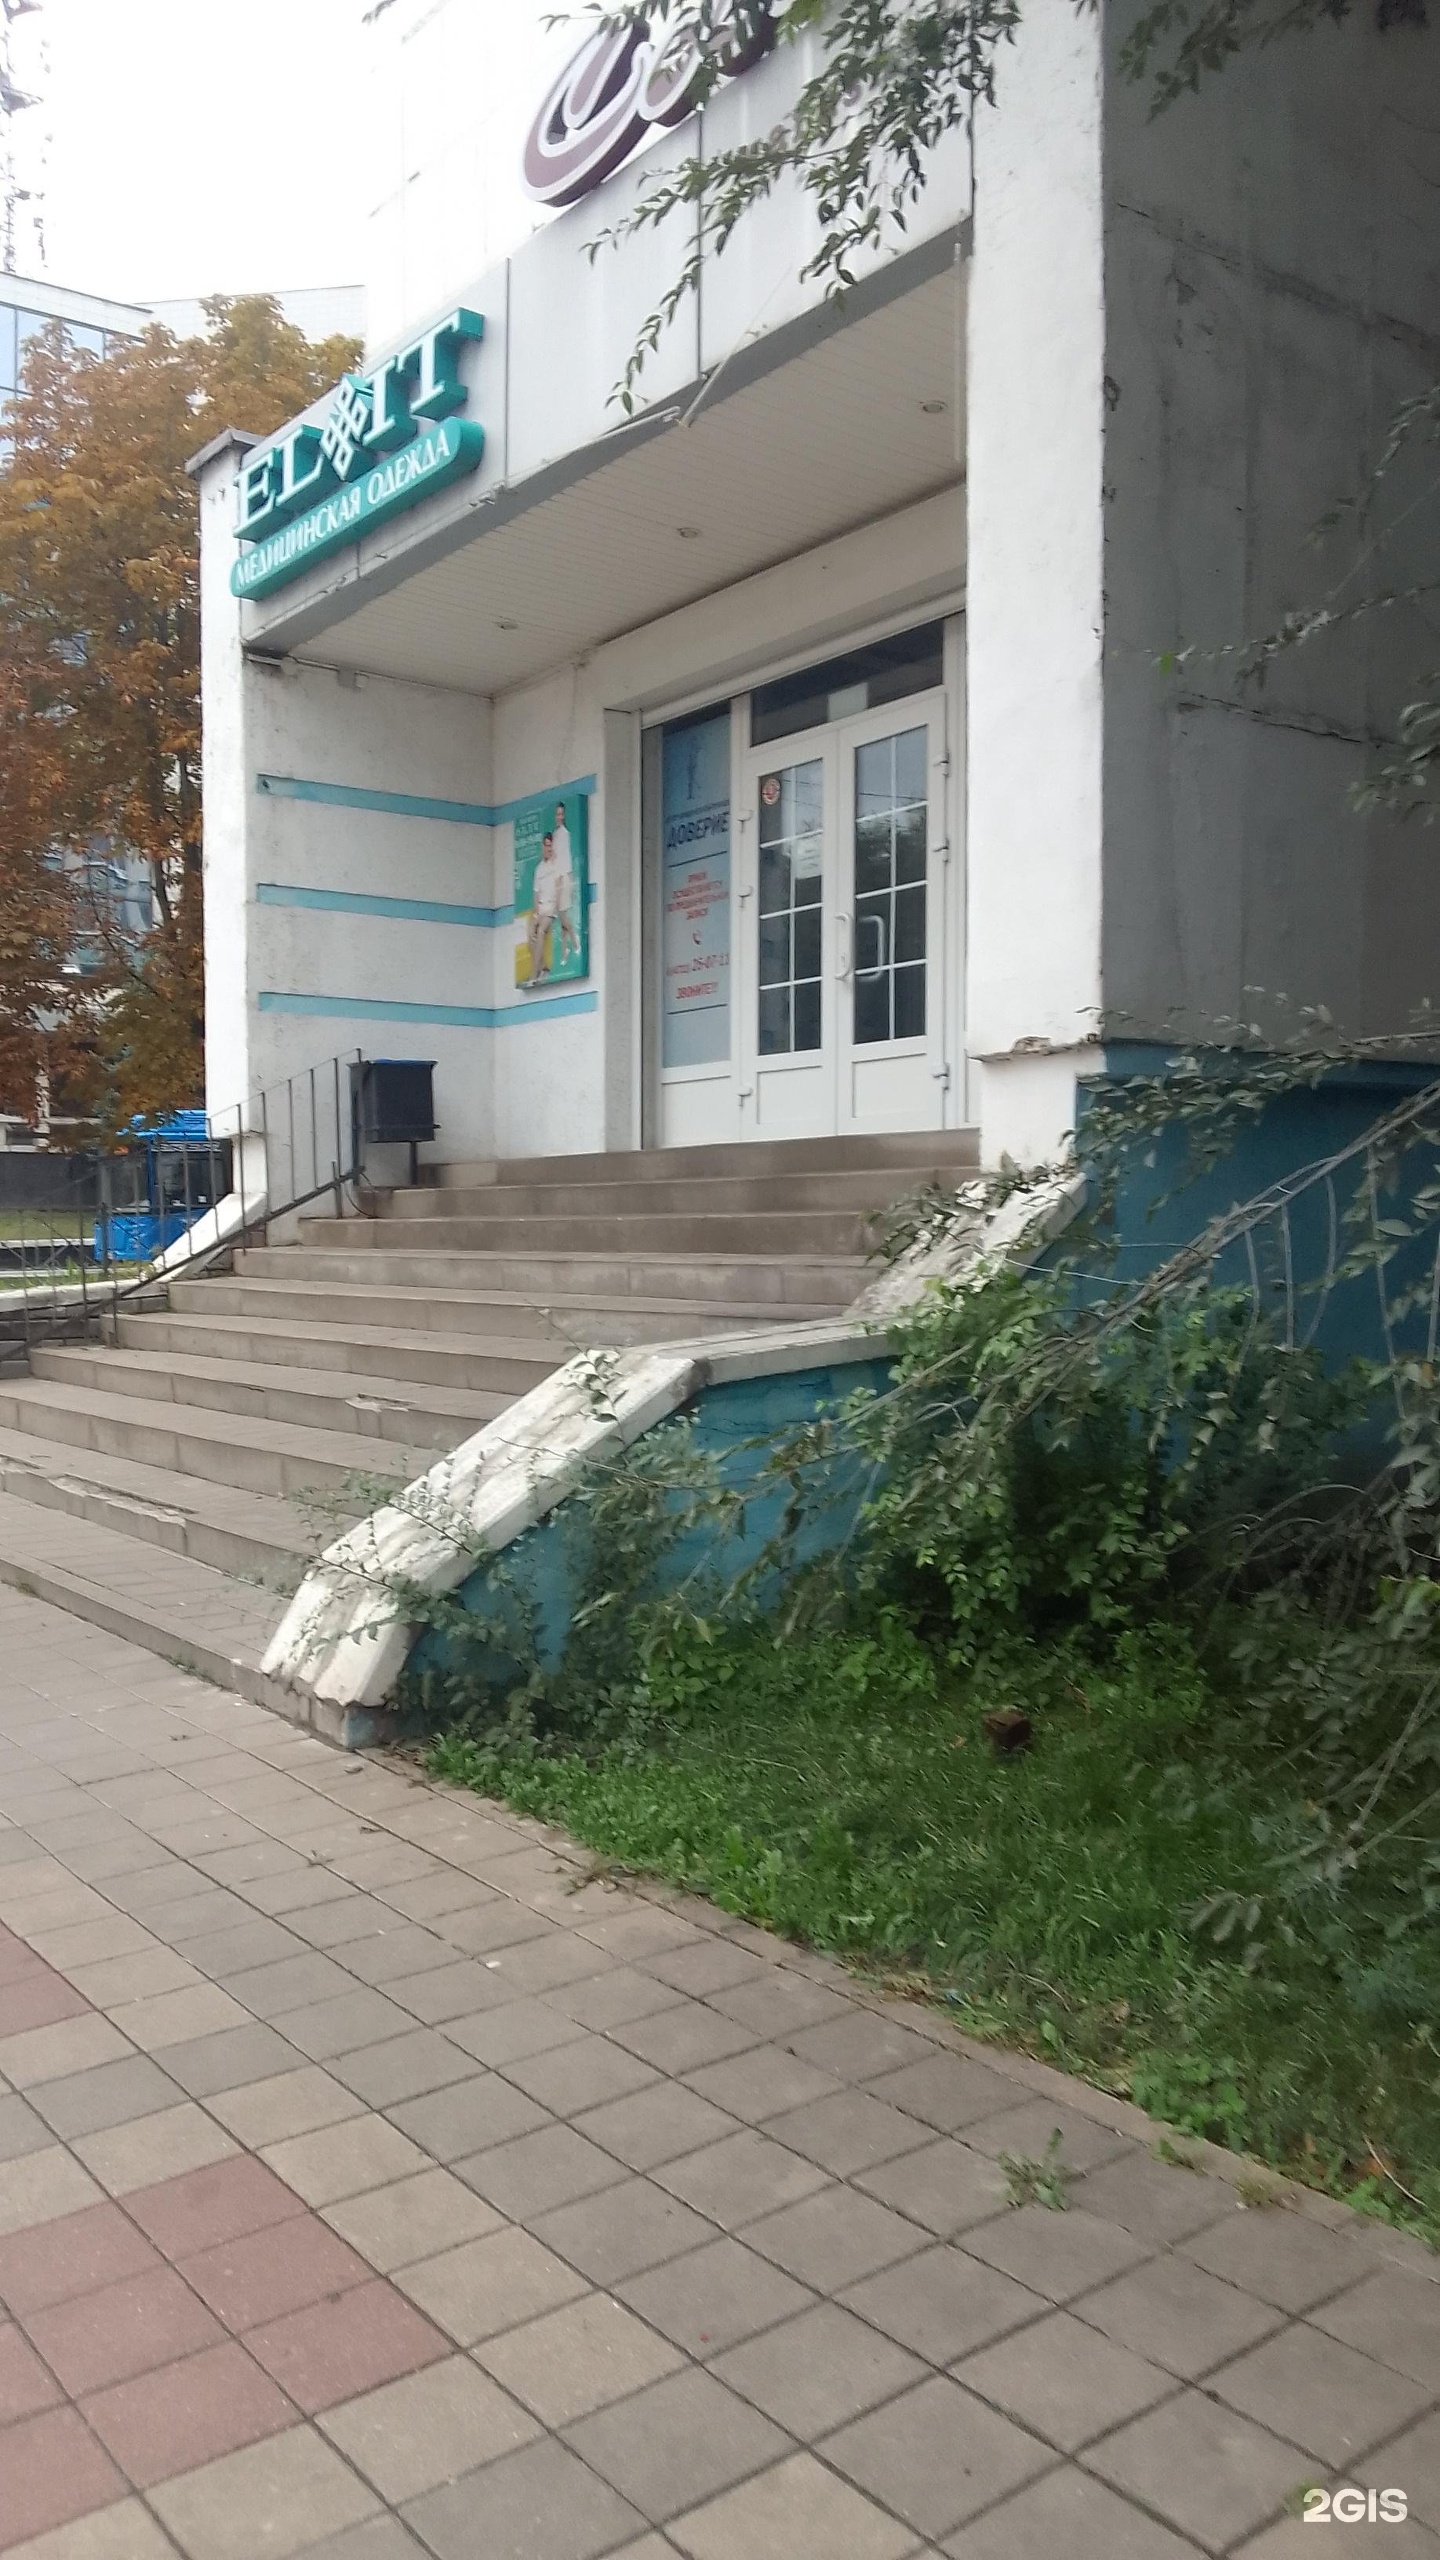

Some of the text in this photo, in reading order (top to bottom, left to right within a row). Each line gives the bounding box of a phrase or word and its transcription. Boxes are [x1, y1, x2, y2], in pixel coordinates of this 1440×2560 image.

[235, 428, 451, 589] МЕДИЦИНСКАЯ ОДЕЖДА
[667, 812, 730, 849] ДОВЕРИЕ
